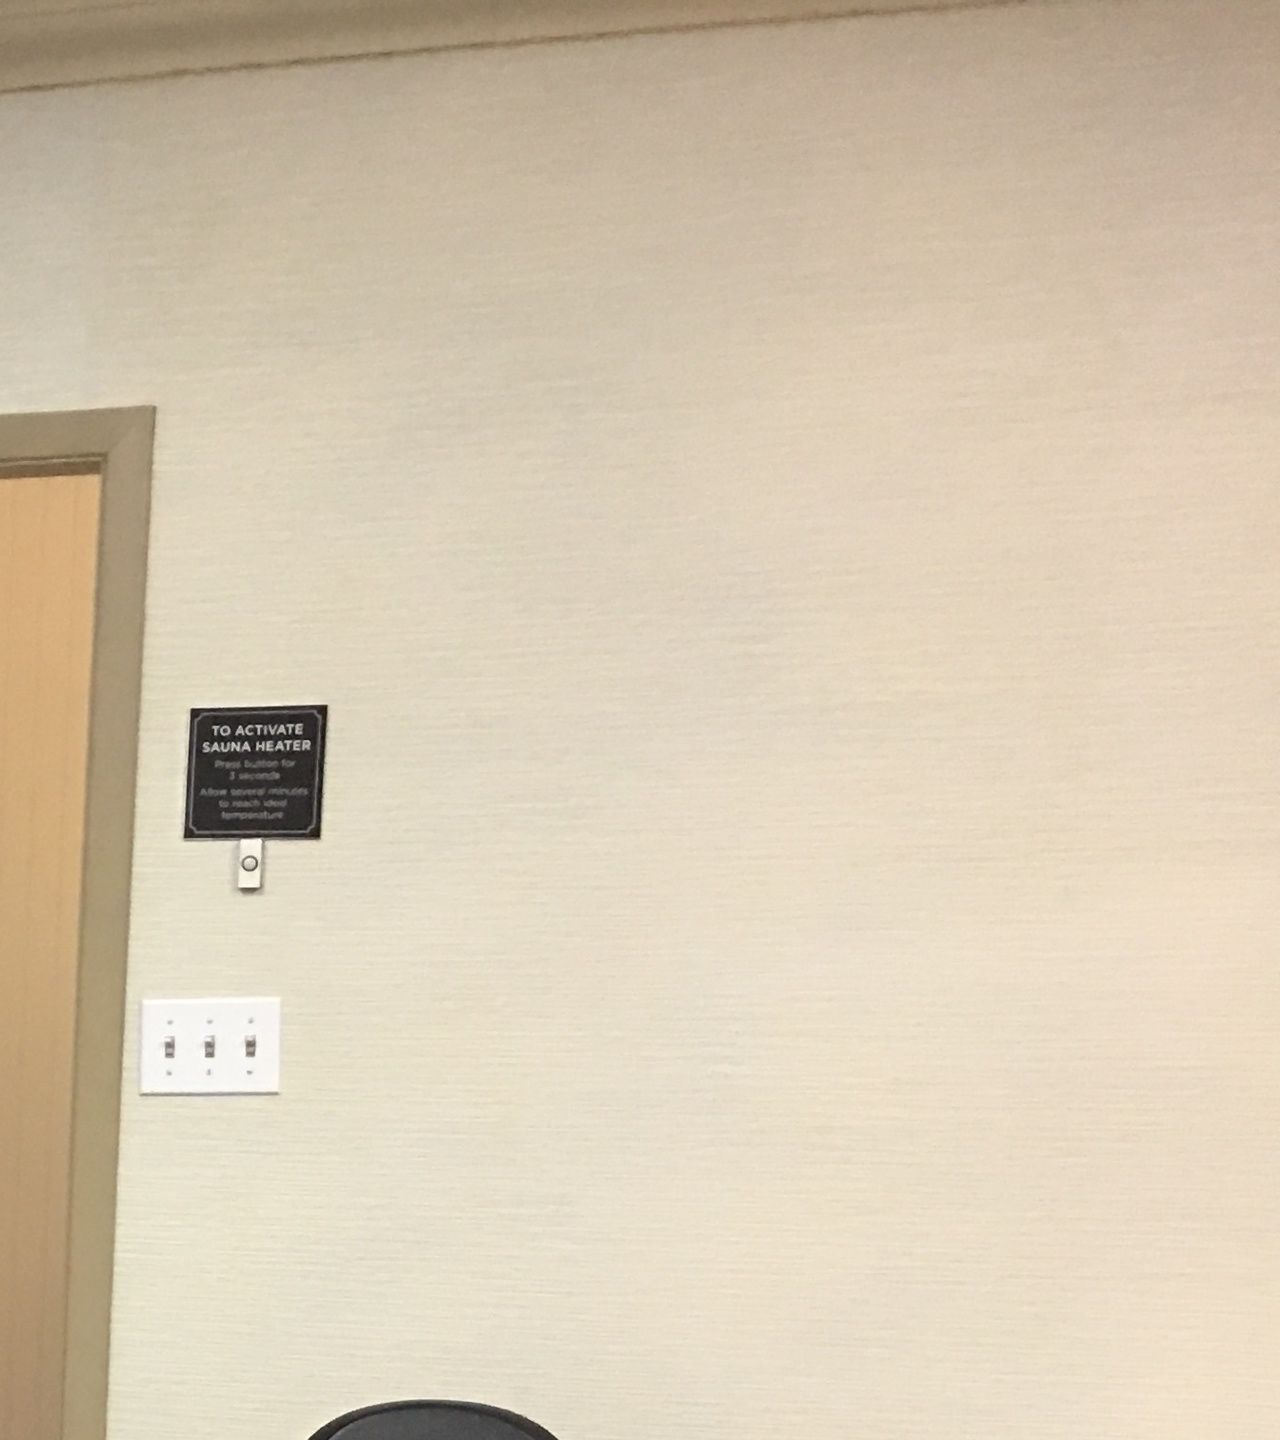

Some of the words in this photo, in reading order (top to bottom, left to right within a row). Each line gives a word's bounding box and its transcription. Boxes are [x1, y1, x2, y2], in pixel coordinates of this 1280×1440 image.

[212, 725, 232, 737] TO
[235, 723, 304, 736] ACTIVATE
[202, 741, 251, 753] SAUNA
[255, 739, 312, 752] HEATER
